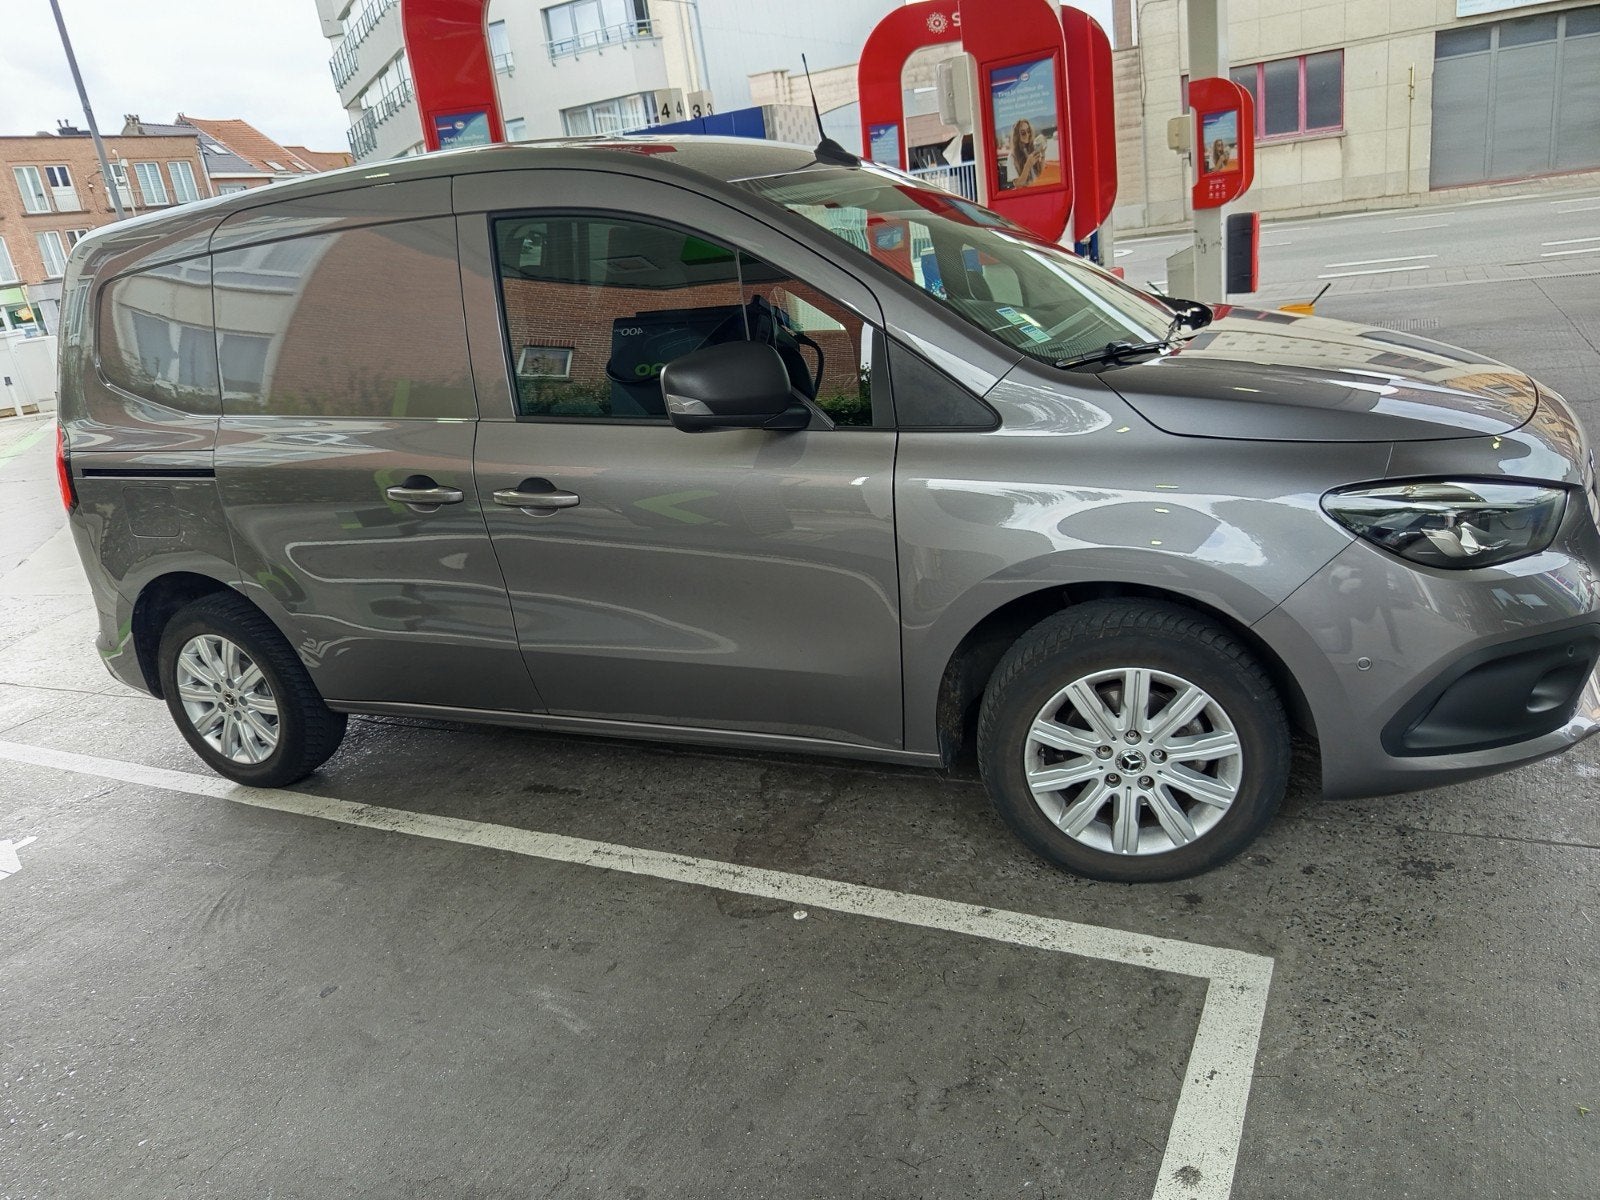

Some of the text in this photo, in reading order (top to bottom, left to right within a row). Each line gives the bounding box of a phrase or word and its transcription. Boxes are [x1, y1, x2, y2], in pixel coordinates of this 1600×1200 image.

[661, 103, 670, 118] 4
[676, 101, 683, 117] 4
[692, 104, 702, 119] 3
[706, 103, 714, 116] 3
